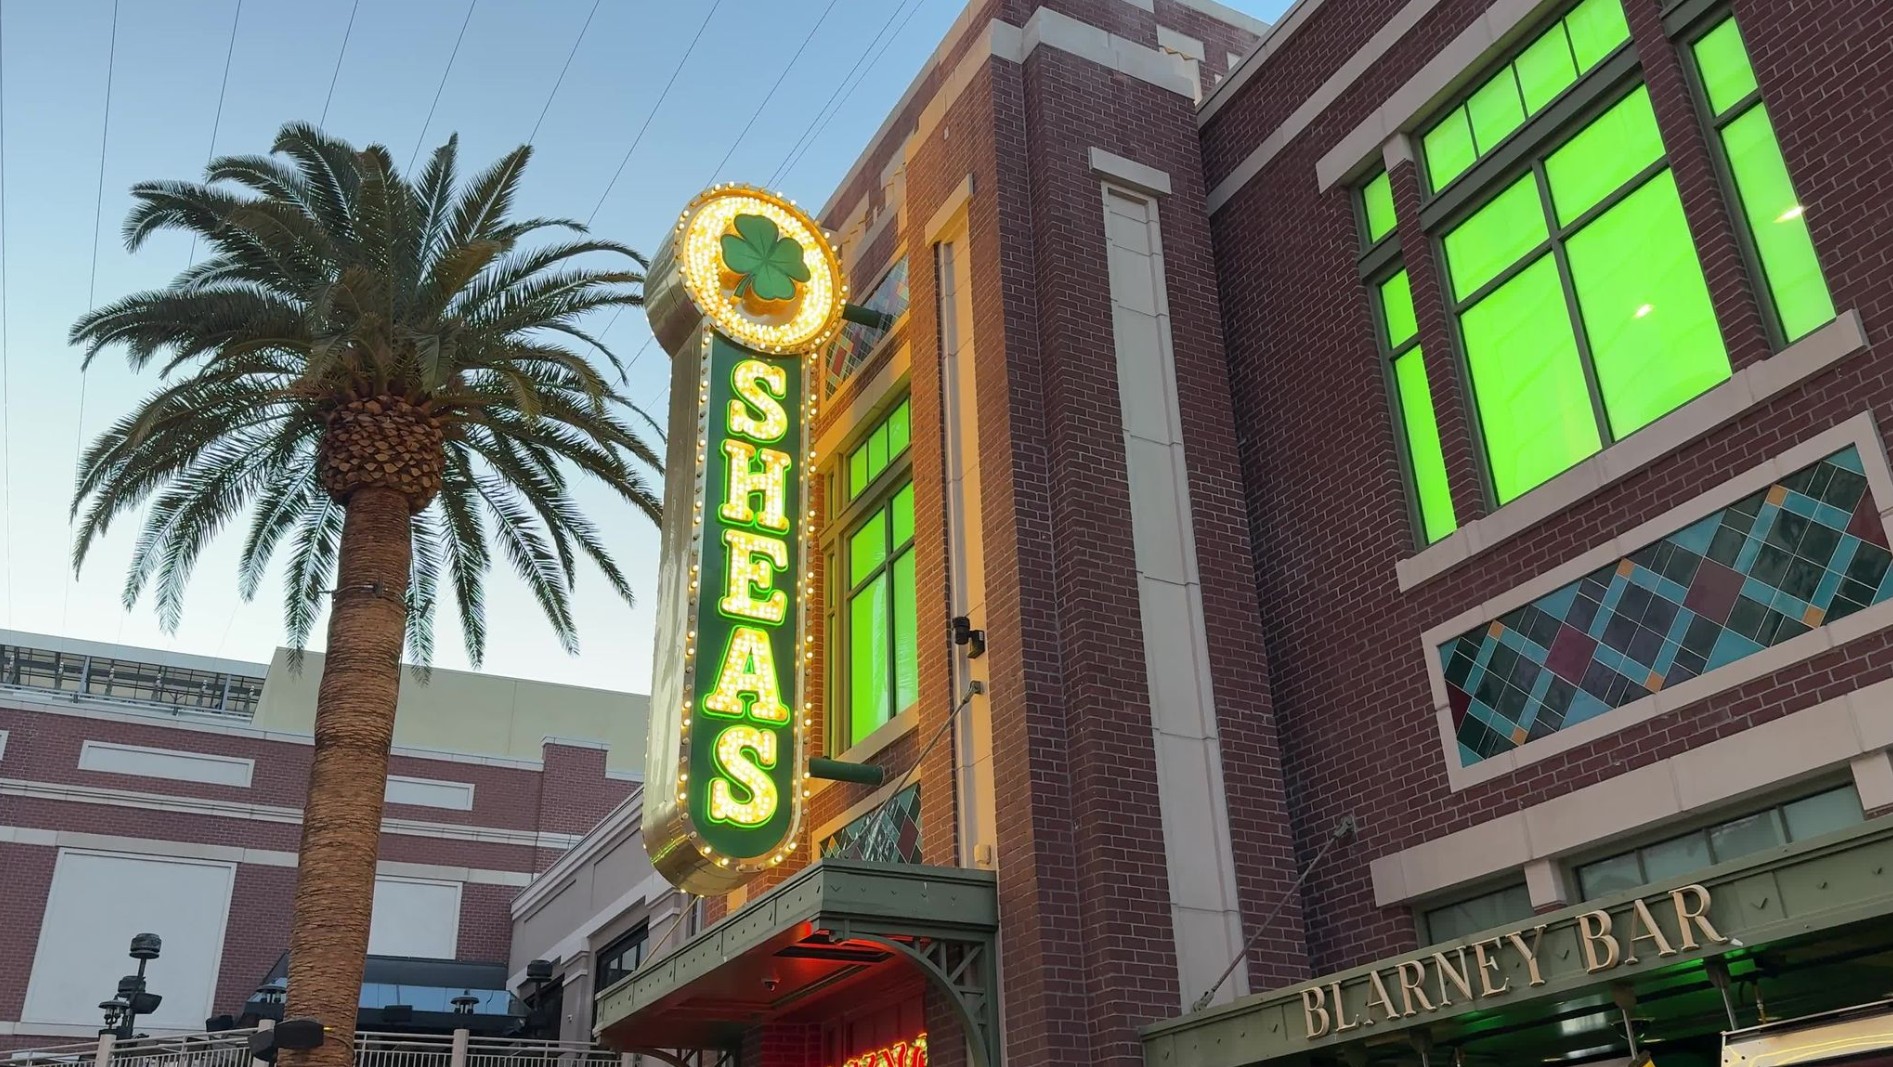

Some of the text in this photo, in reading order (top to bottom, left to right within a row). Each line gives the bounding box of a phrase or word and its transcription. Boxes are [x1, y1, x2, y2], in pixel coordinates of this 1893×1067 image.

[702, 359, 792, 827] SHEAS
[1302, 884, 1728, 1040] BLARNEY BAR
